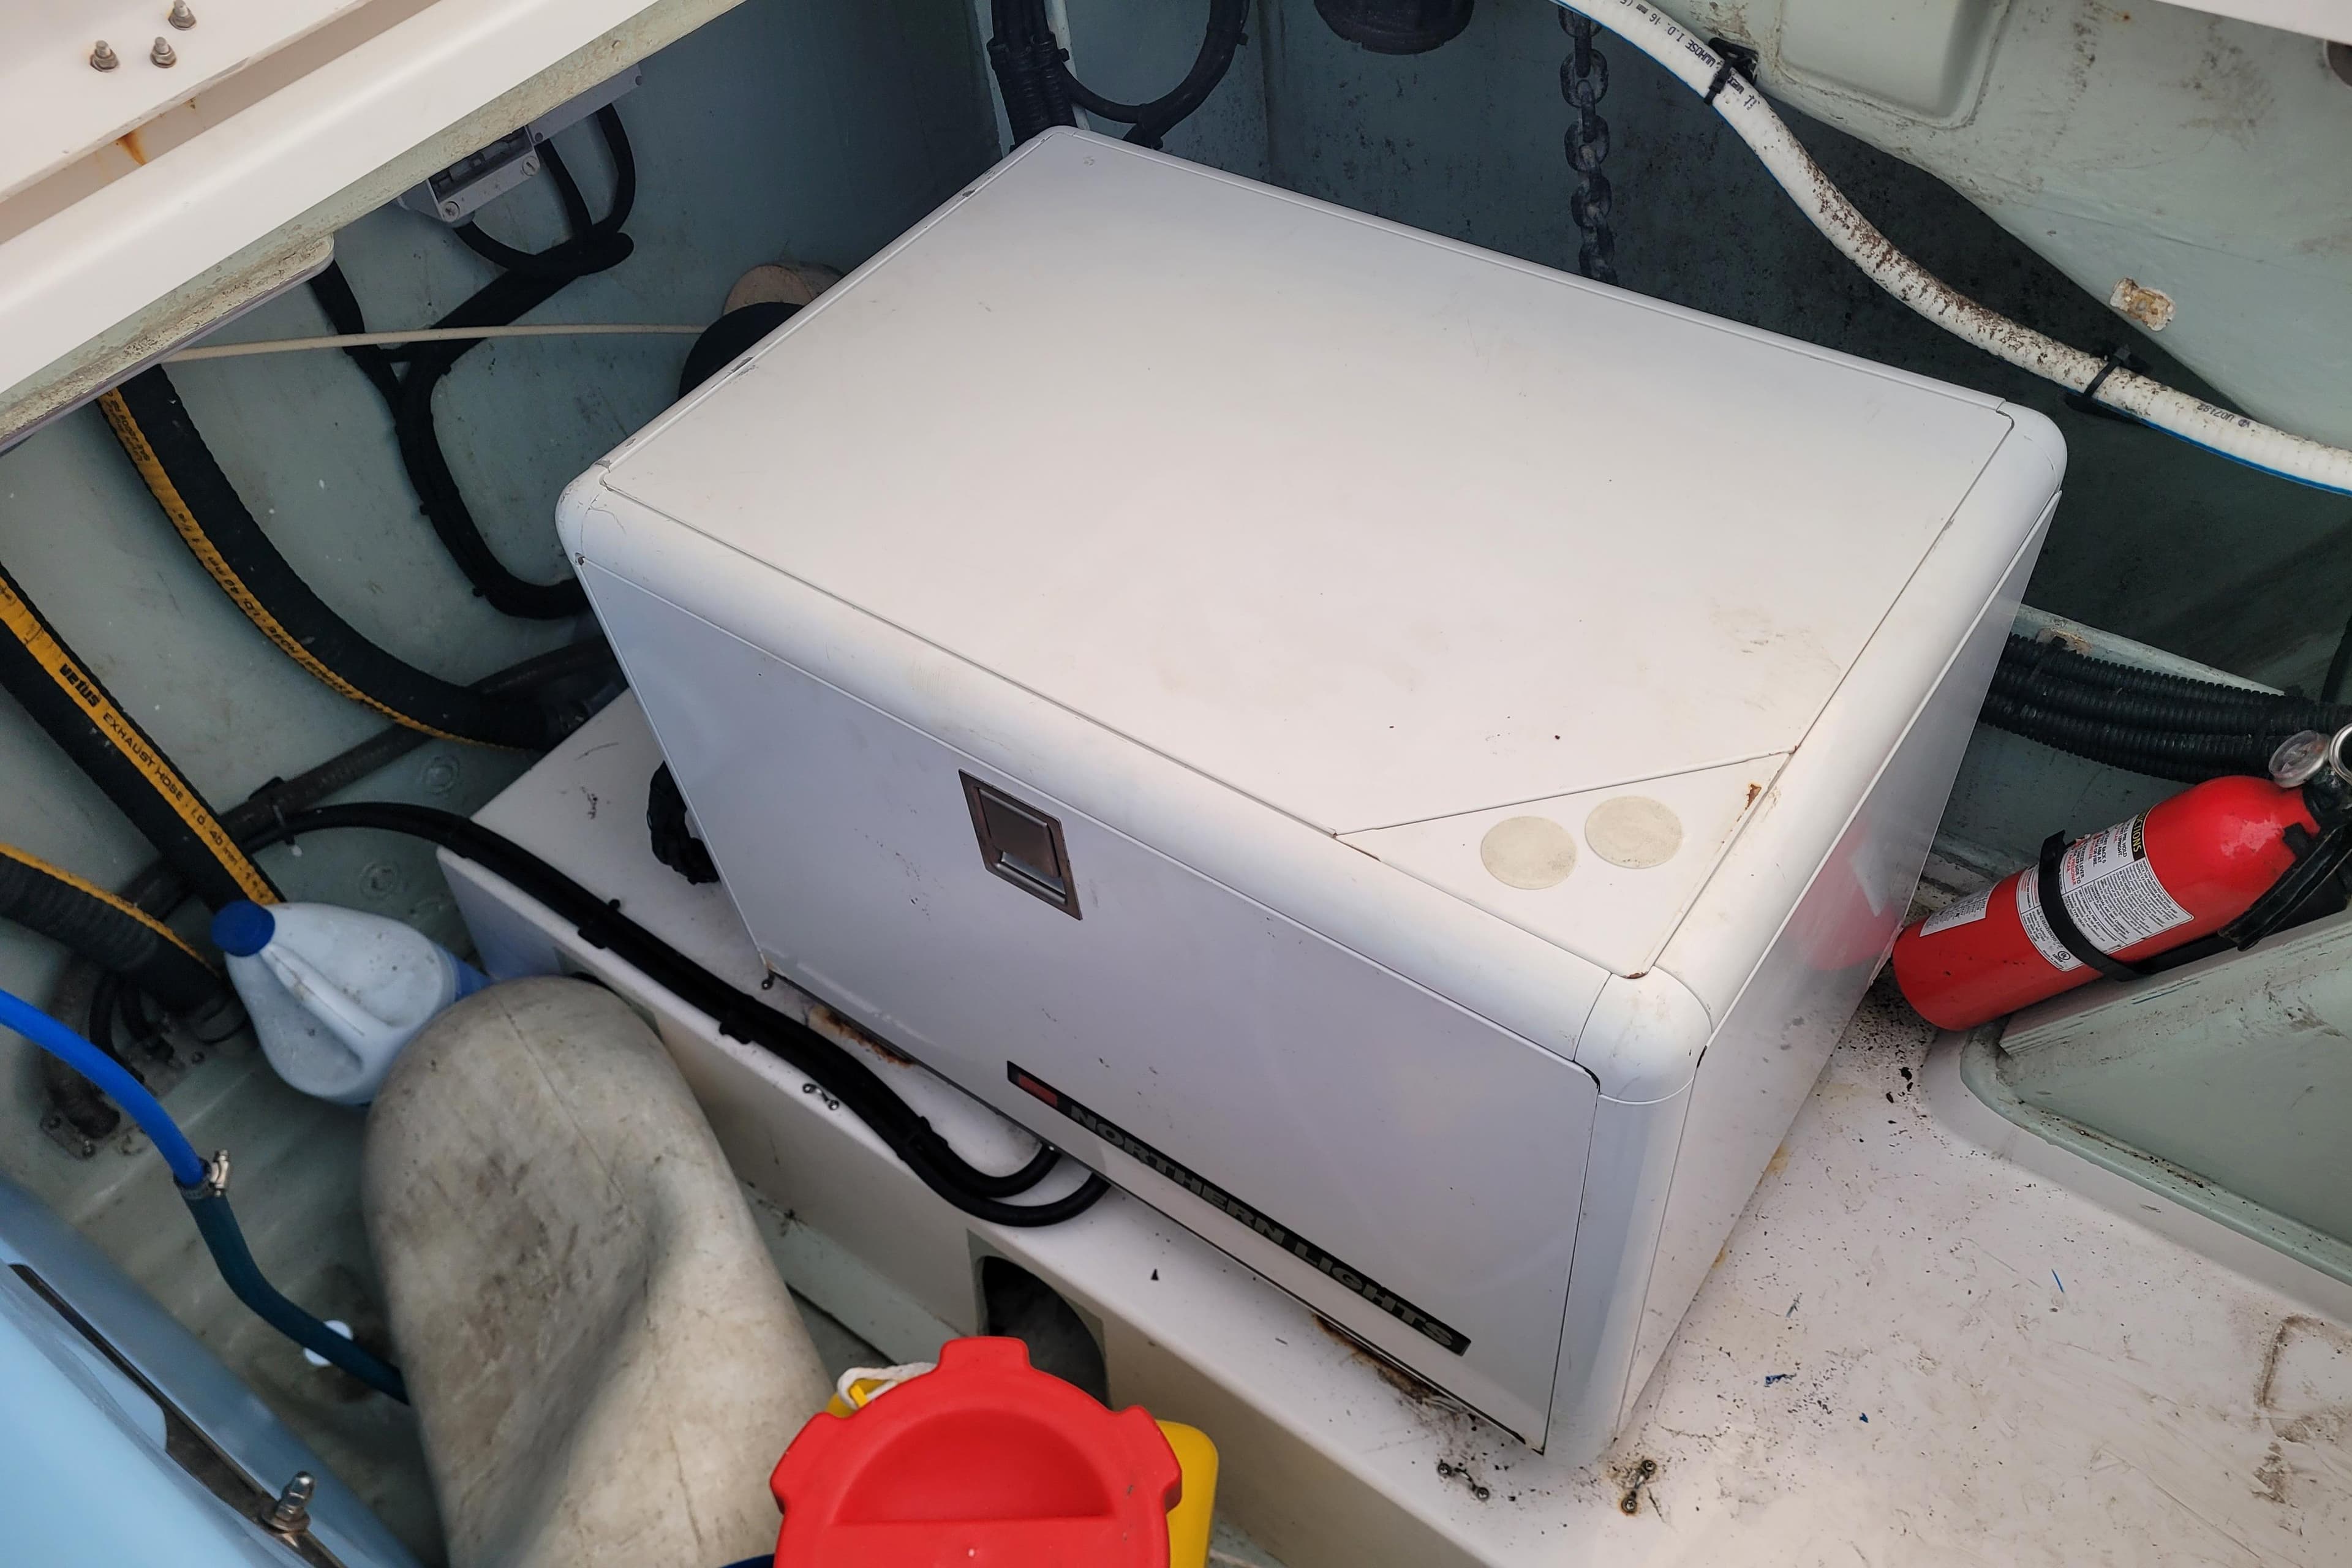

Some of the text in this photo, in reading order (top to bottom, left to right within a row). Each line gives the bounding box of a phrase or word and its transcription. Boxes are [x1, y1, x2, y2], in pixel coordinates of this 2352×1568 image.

[102, 712, 156, 768] EXHAUST
[2076, 875, 2081, 884] TO
[1071, 1106, 1453, 1347] NORTHERN LIGHTS
